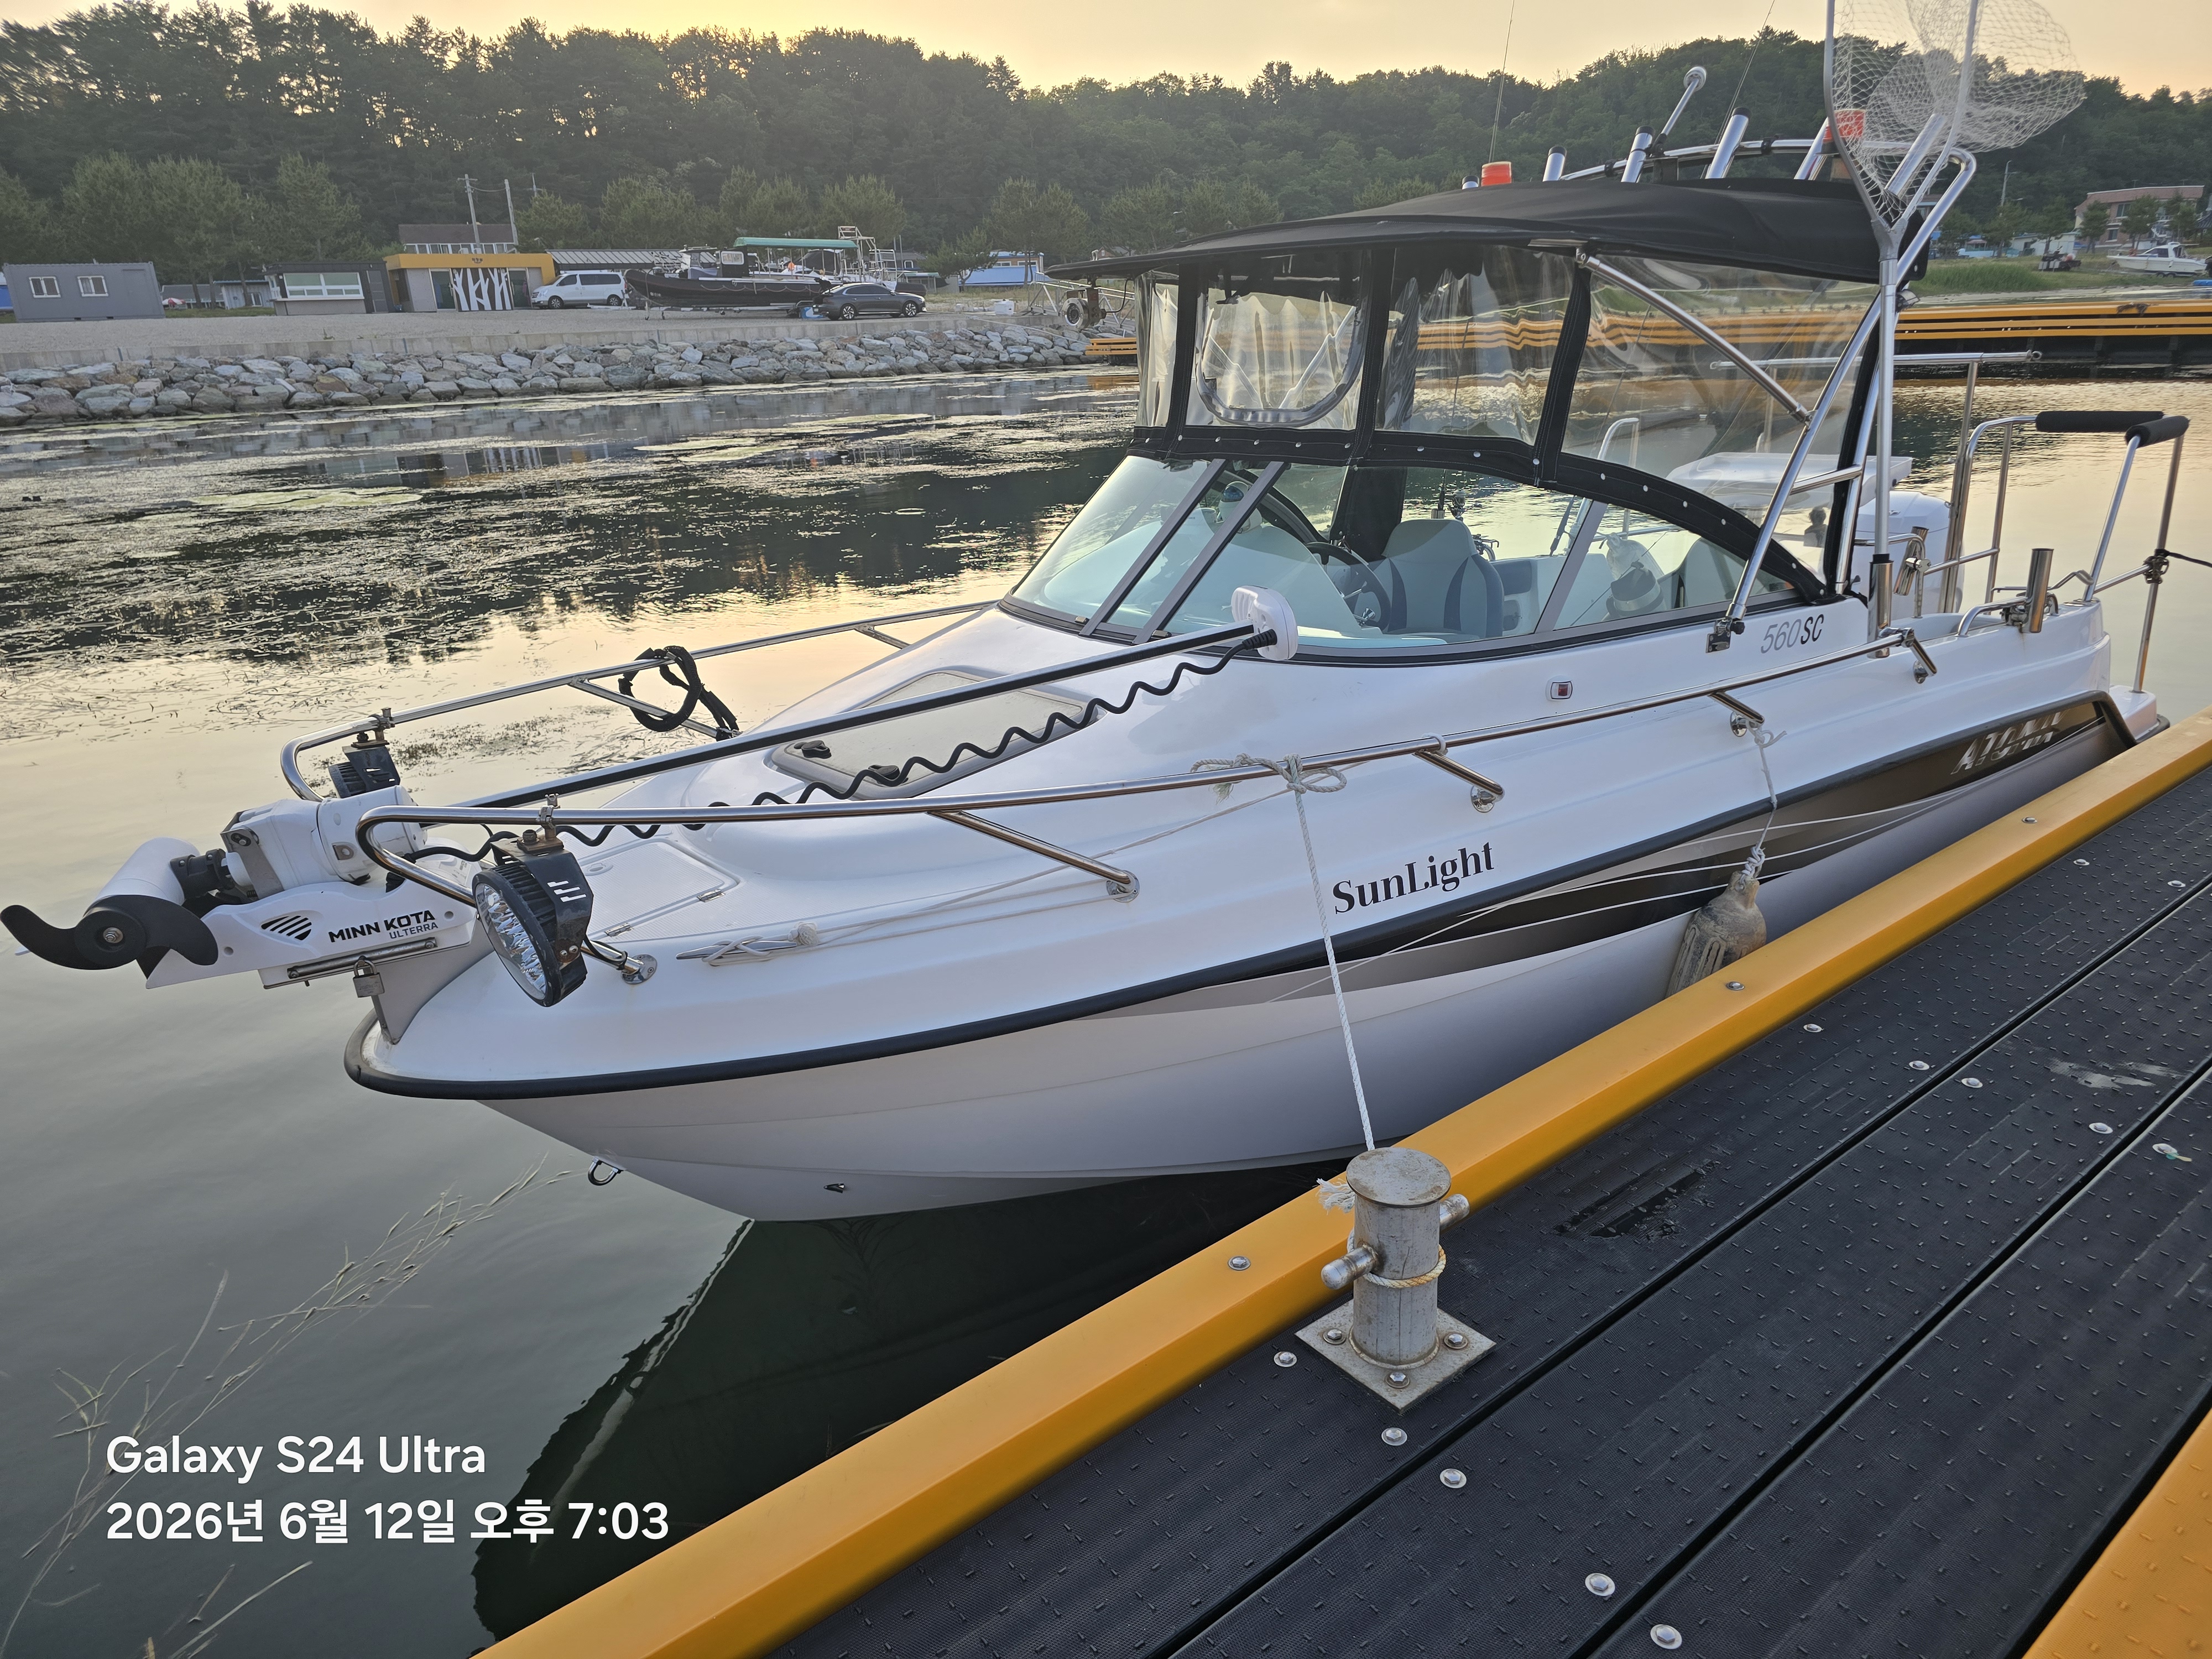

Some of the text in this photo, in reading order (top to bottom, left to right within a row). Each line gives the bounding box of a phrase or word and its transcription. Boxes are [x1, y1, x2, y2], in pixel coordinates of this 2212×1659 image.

[1760, 613, 1824, 654] 560SC
[1332, 841, 1494, 915] SunLight
[328, 910, 436, 943] MINN KOTA
[389, 922, 439, 939] ULTERRA
